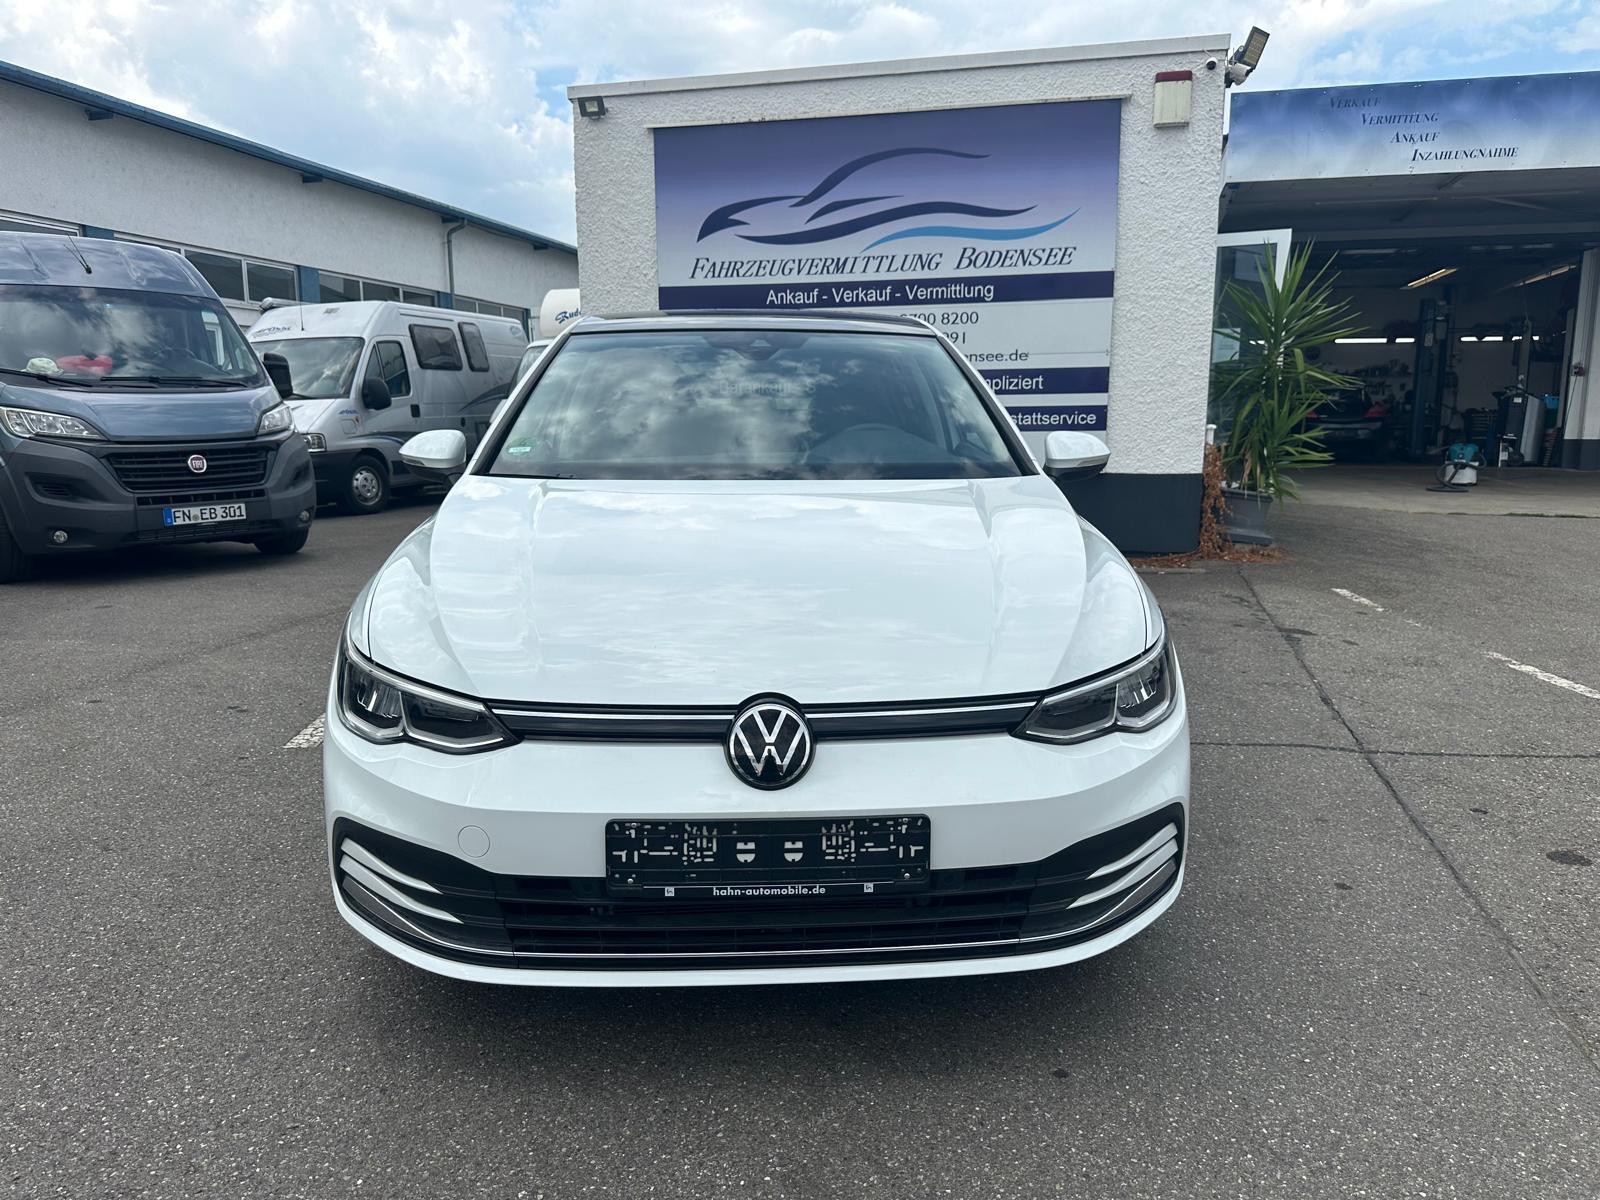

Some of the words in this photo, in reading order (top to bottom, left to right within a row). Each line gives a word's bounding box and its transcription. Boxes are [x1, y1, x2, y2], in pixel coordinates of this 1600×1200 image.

[1329, 97, 1382, 109] VERKAUF
[1361, 112, 1440, 126] VERMITTLUNG
[1390, 130, 1441, 144] ANKAUF
[1411, 146, 1520, 162] INZAHLUNGNAHME
[688, 252, 944, 280] FAHRZEUGVERMITTLUNG
[953, 246, 1078, 271] BODENSEE
[766, 289, 820, 305] Ankauf
[831, 286, 891, 303] Verkauf
[905, 283, 995, 302] Vermittlung
[941, 311, 979, 326] 8200
[173, 509, 192, 523] FN
[200, 507, 218, 521] EB
[220, 505, 245, 519] 301
[712, 884, 827, 897] hahn-automobile.de
